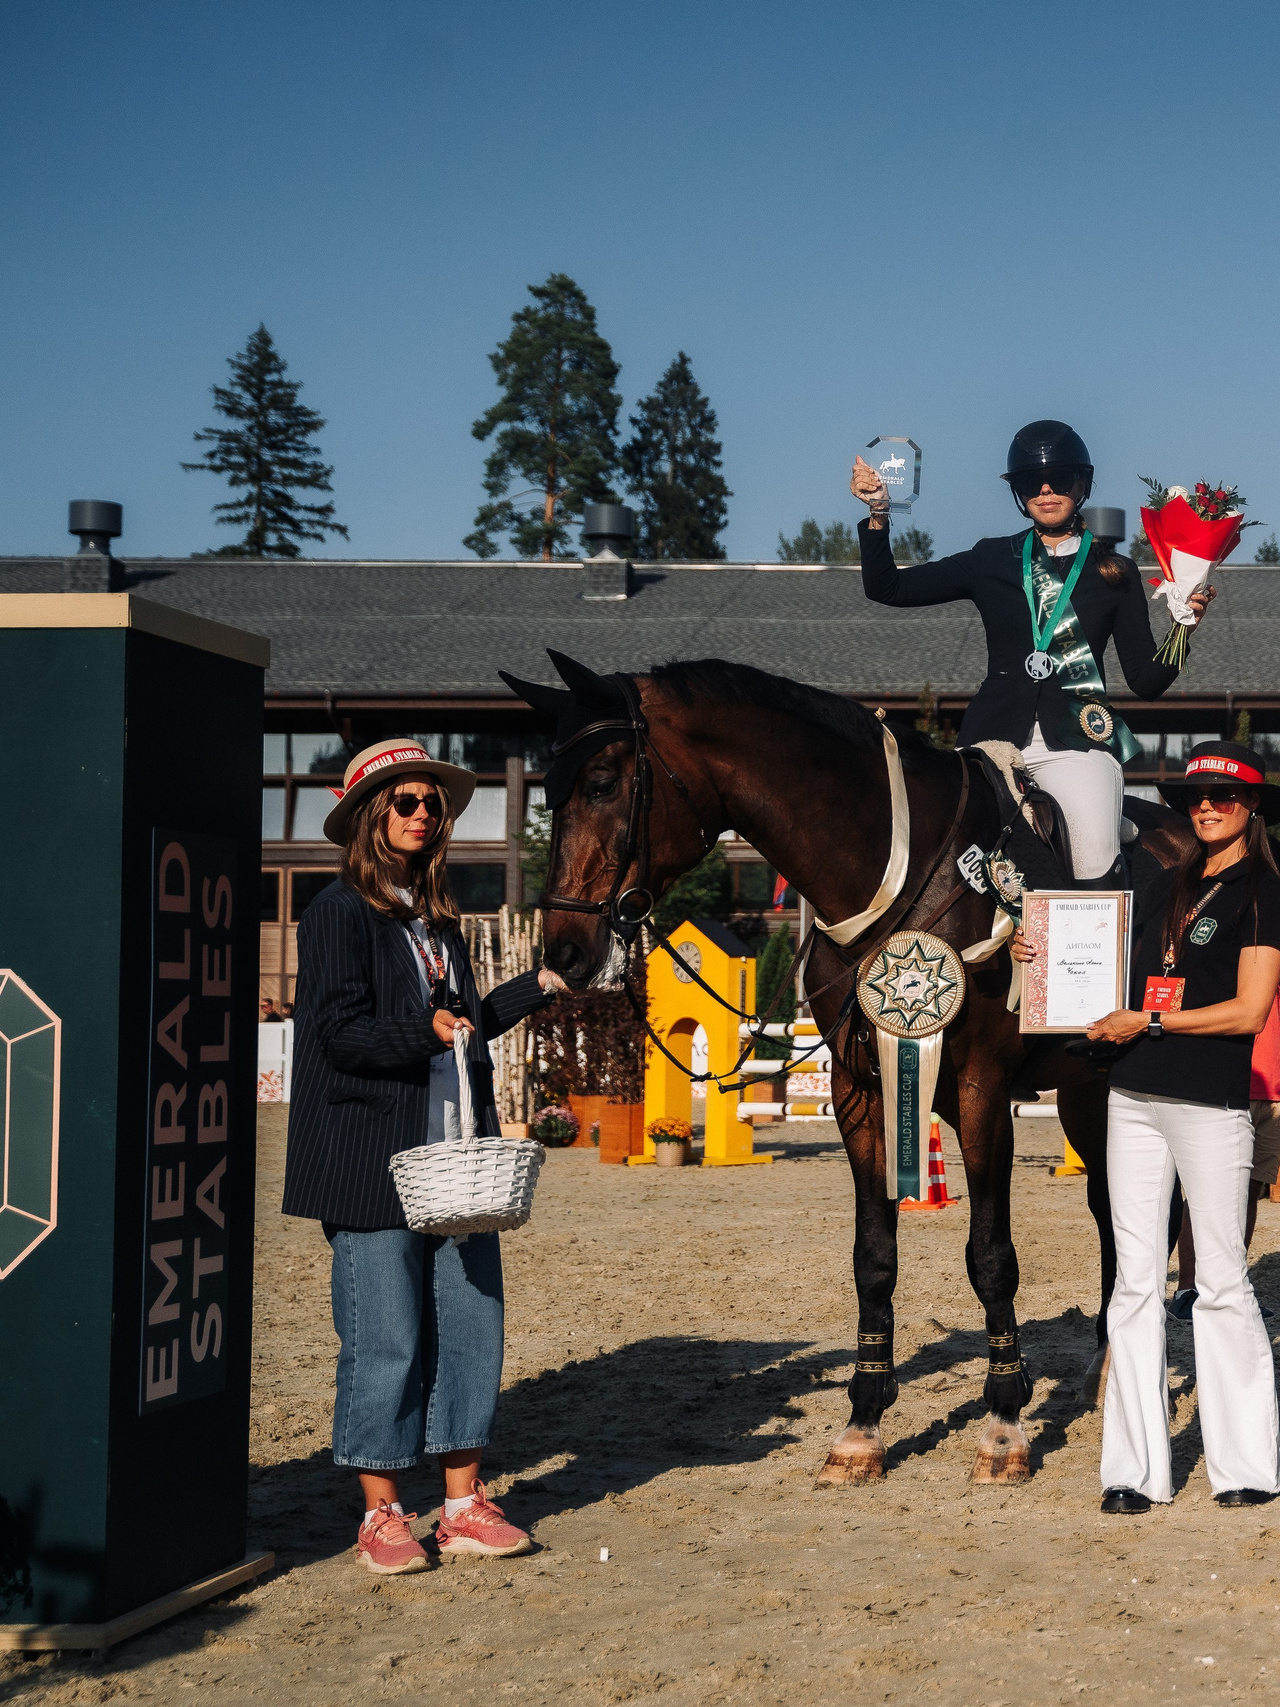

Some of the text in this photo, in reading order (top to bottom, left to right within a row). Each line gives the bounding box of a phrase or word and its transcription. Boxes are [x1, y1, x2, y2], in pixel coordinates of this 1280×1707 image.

[363, 755, 394, 776] EMERALD
[394, 750, 423, 761] STABLES
[1200, 760, 1225, 770] STABLES
[1227, 762, 1238, 774] CUP
[146, 841, 191, 1402] EMERALD
[191, 873, 234, 1363] STABLES
[903, 1074, 912, 1167] EMERALD STABLES CUP
